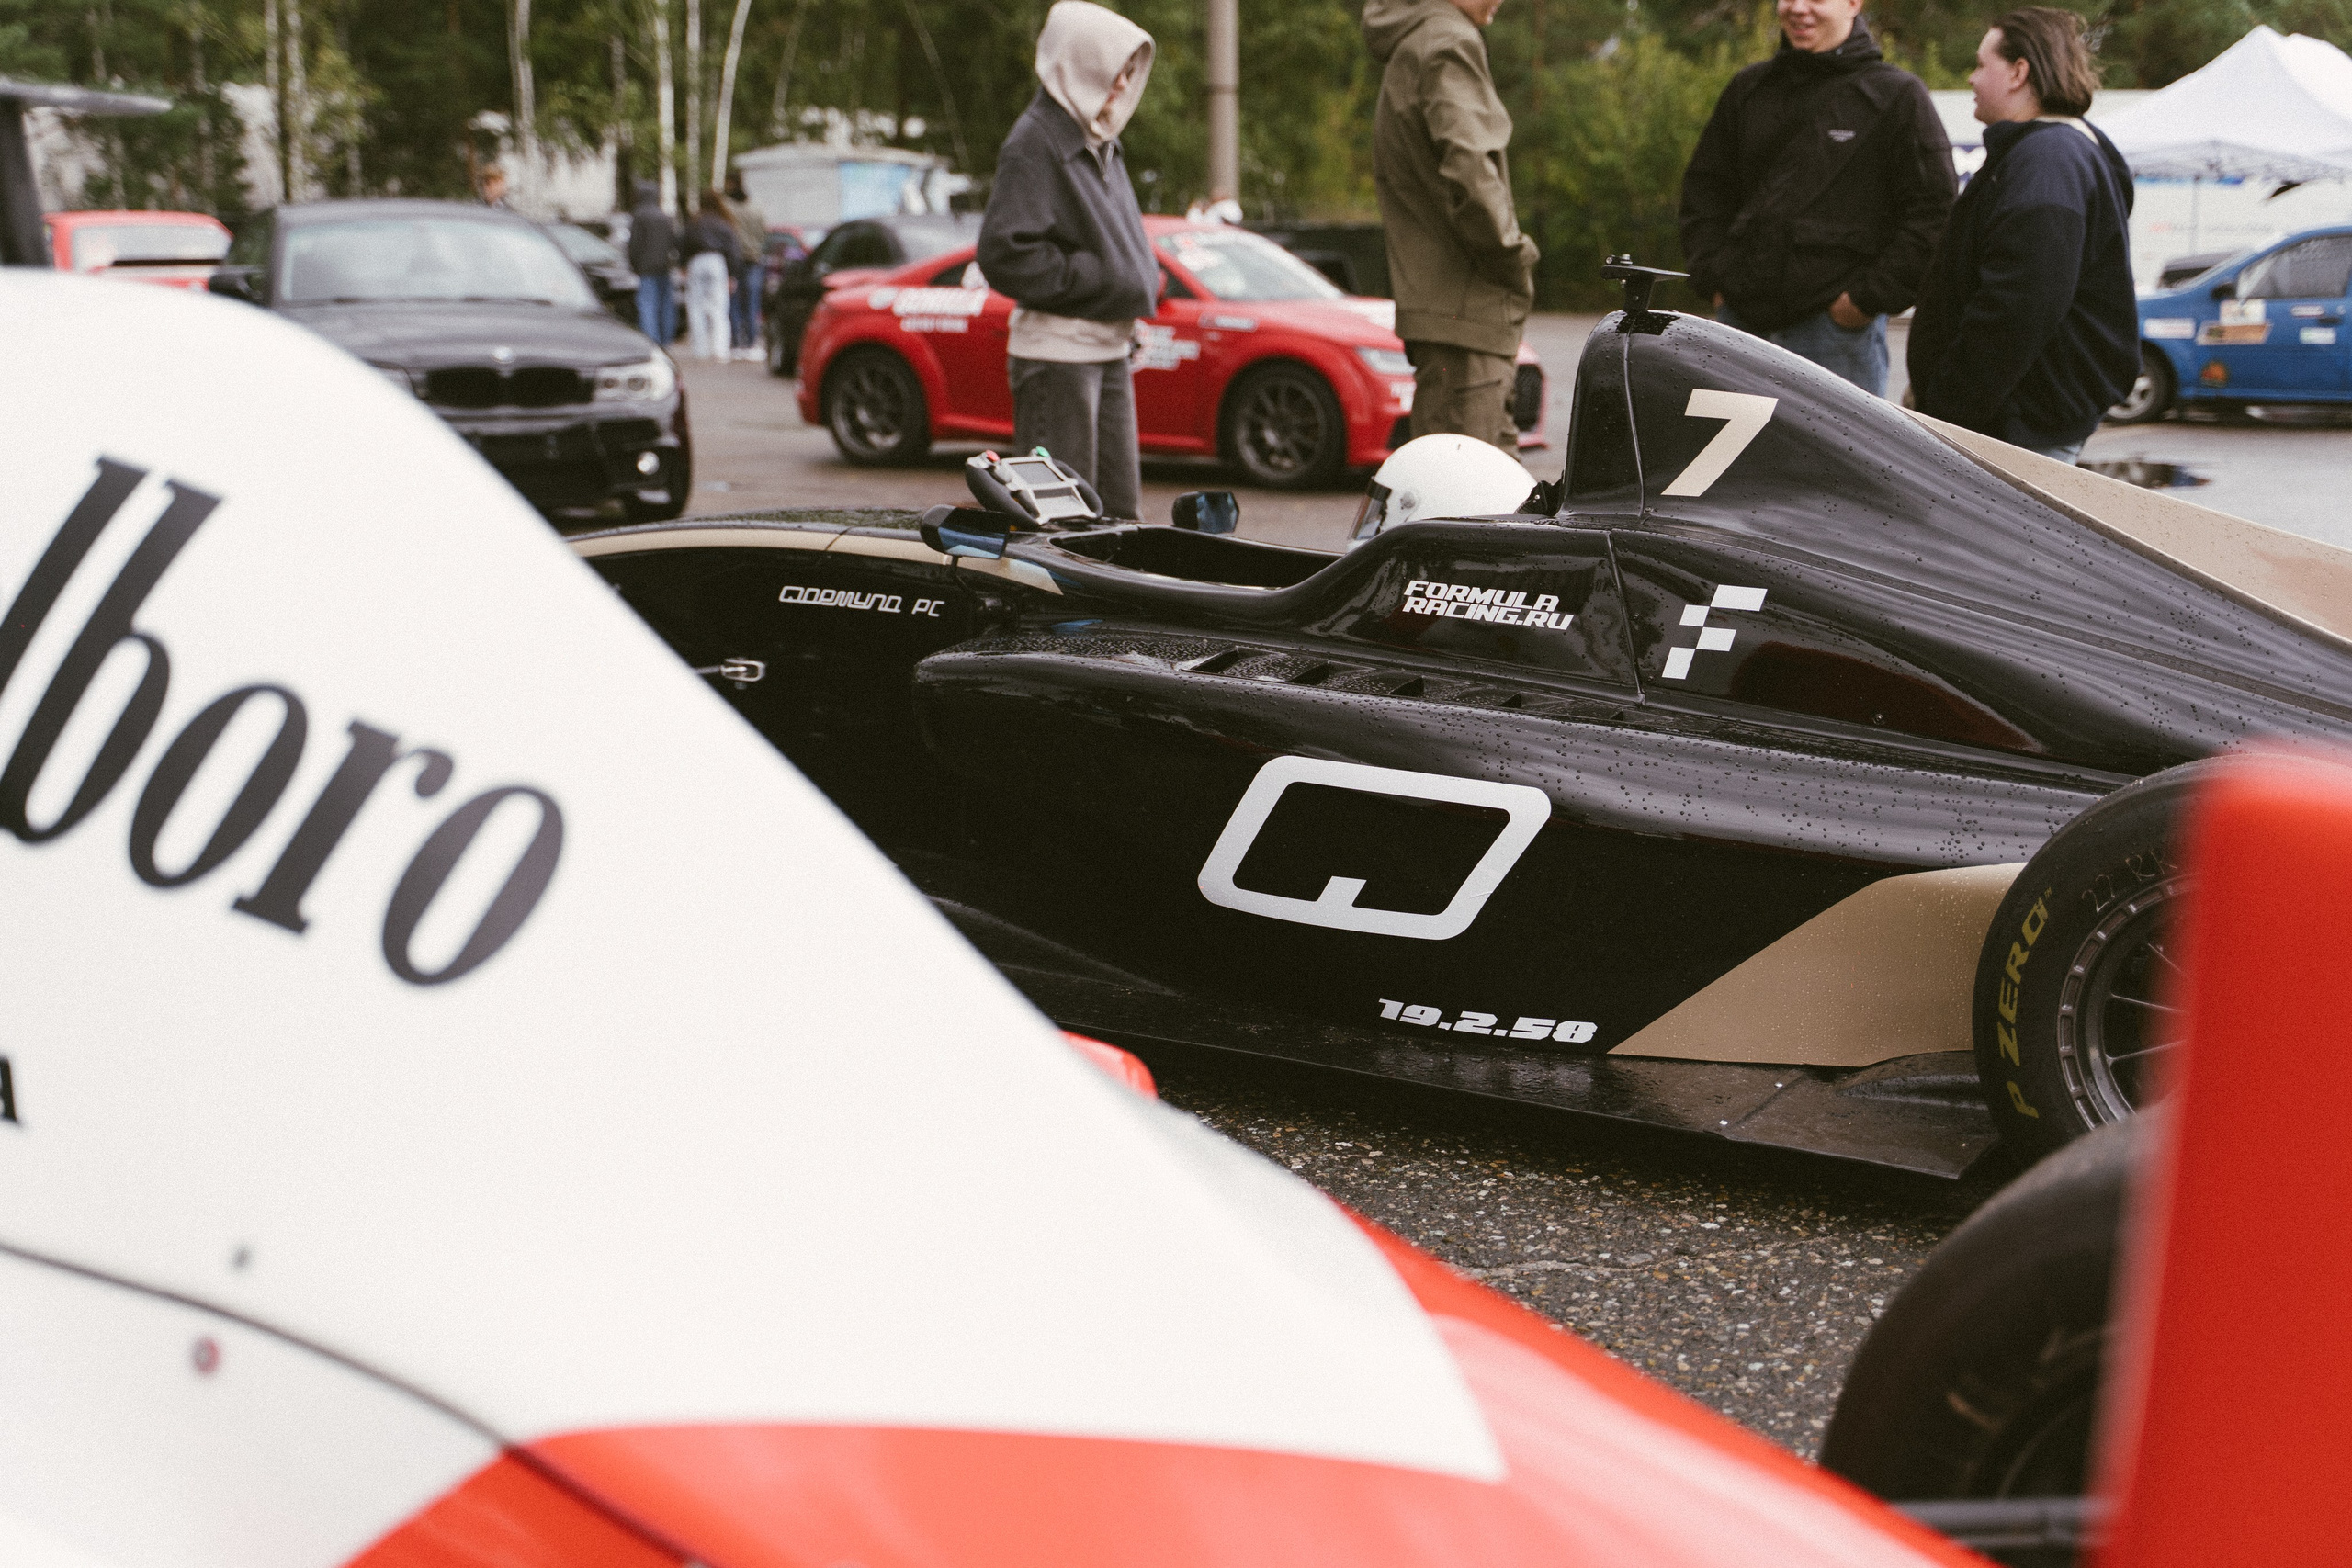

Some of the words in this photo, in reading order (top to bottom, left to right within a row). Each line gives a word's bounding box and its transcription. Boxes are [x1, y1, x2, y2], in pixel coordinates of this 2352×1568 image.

[1660, 389, 1779, 497] 7
[1402, 596, 1575, 630] RACING.RU
[1403, 580, 1560, 612] FORMULA
[1378, 998, 1599, 1044] 19.2.58
[2007, 1080, 2040, 1119] P
